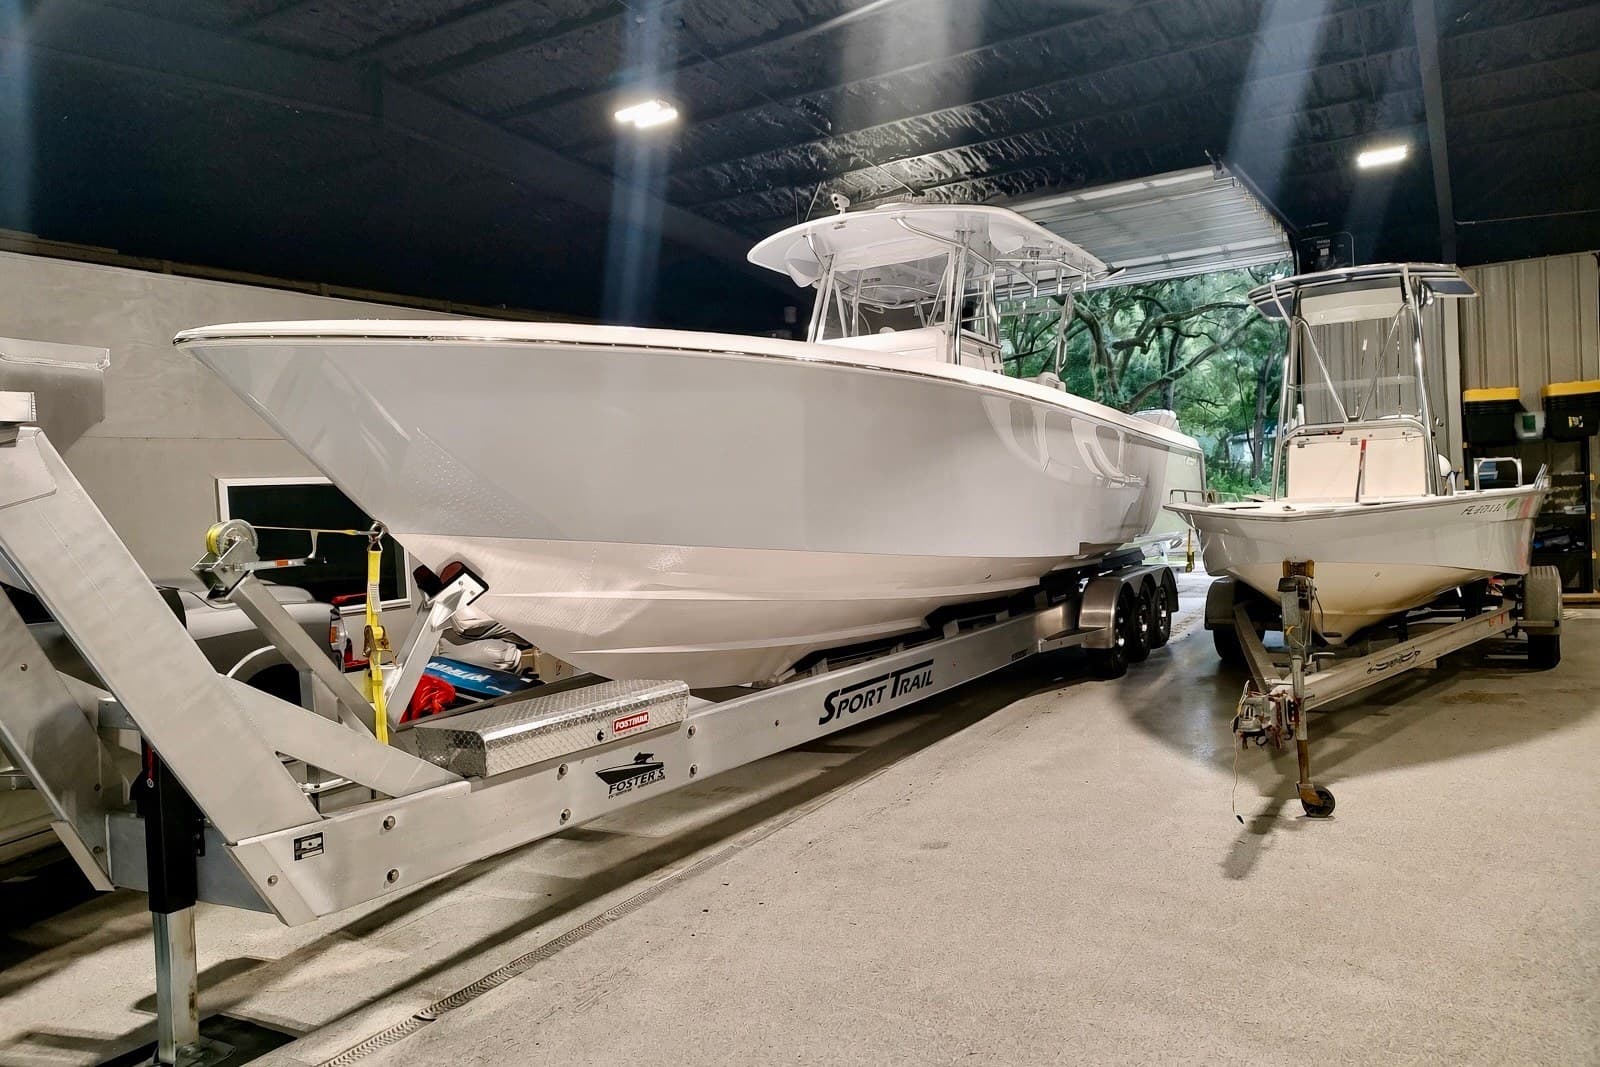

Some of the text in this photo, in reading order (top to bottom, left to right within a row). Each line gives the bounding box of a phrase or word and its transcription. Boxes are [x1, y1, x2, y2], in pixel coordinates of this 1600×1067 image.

[818, 658, 935, 726] SPORT TRAIL
[608, 767, 665, 795] FOSTER'S
